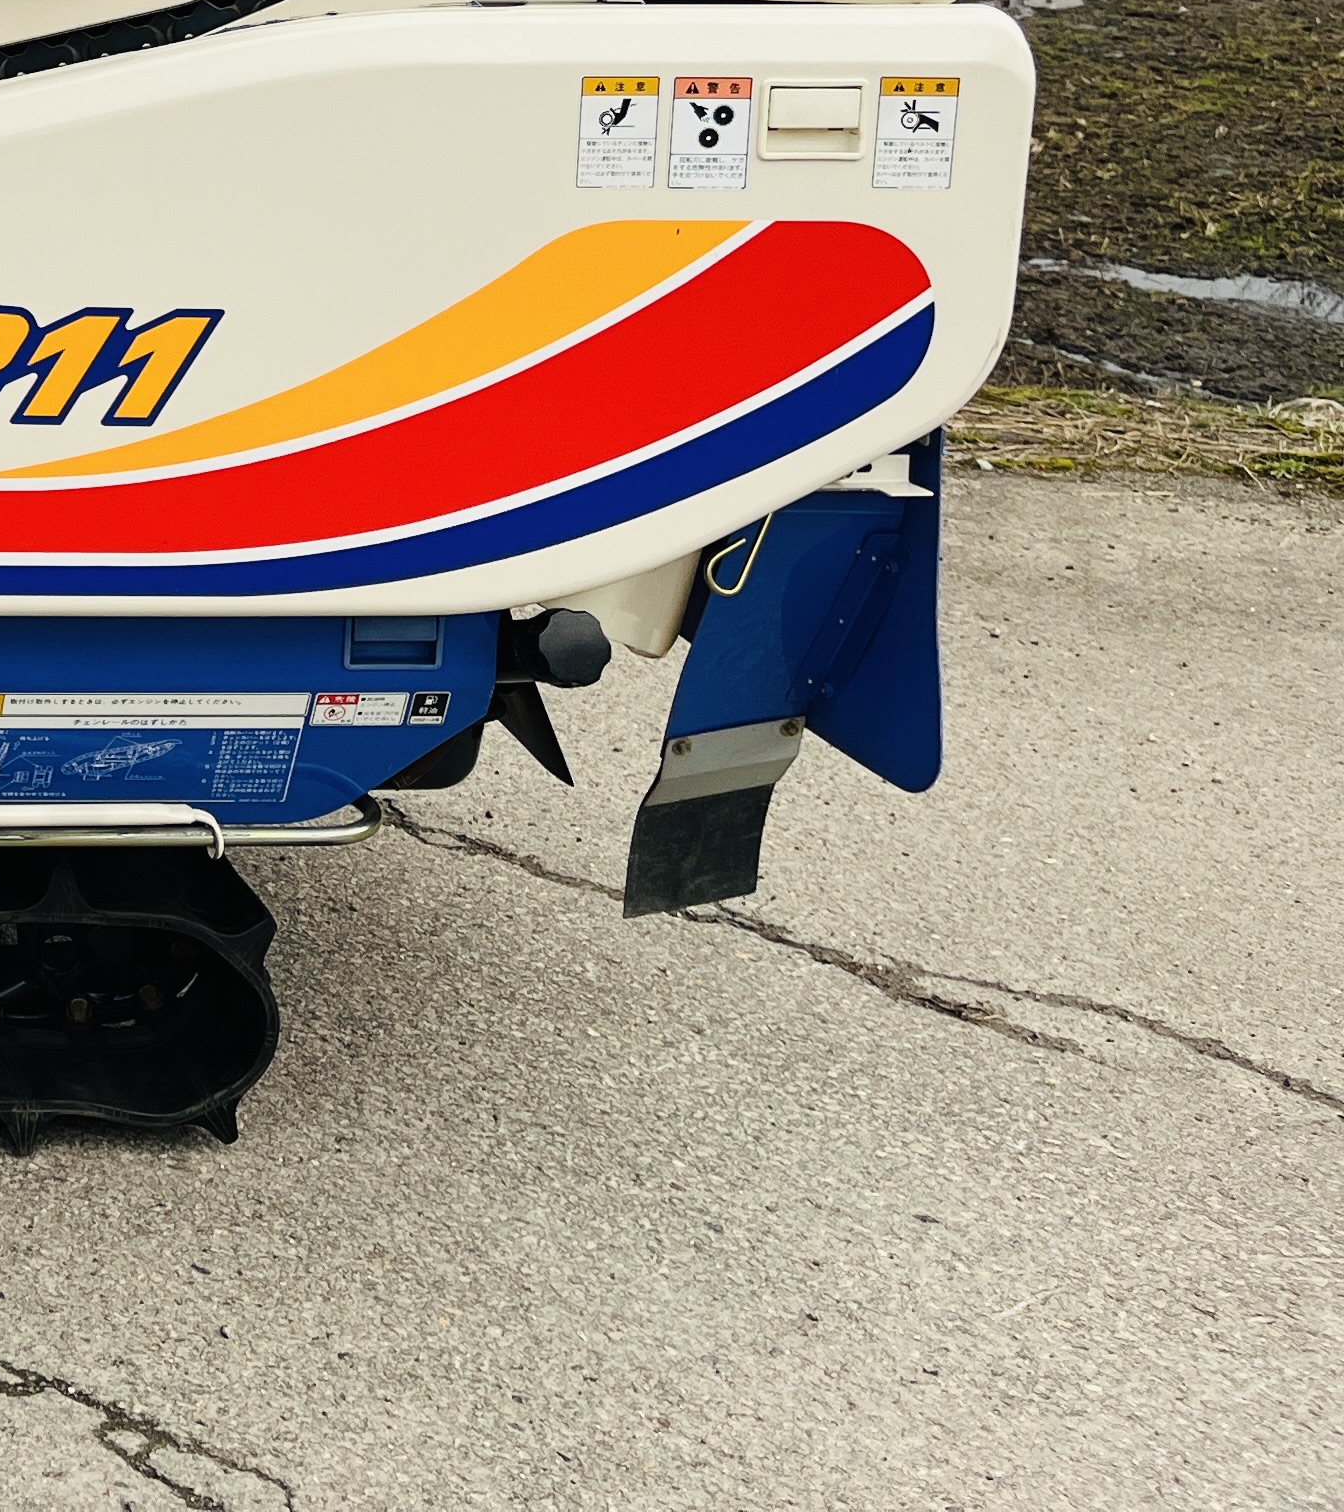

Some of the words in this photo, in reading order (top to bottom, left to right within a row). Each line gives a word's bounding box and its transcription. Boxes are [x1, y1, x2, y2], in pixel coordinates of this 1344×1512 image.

[614, 81, 646, 92] 注意
[707, 82, 741, 94] 警告
[913, 82, 946, 92] 注意
